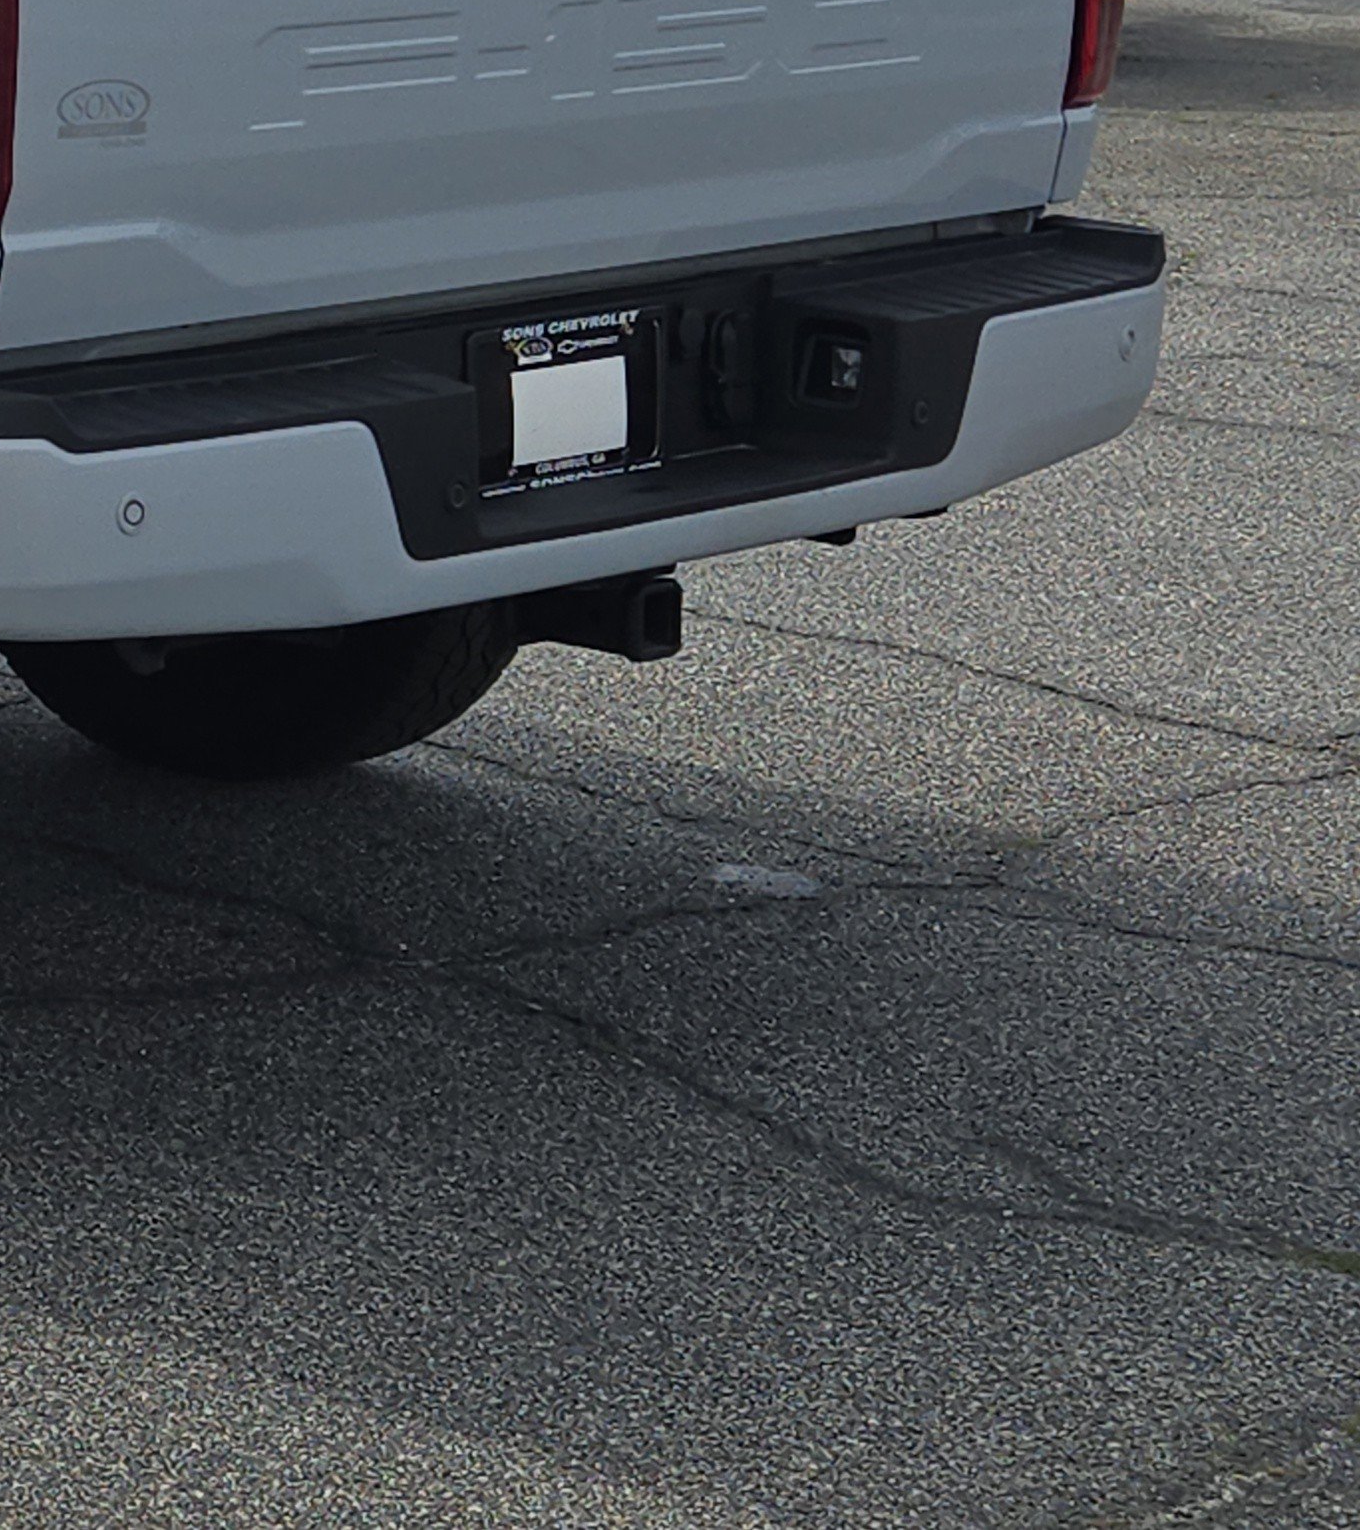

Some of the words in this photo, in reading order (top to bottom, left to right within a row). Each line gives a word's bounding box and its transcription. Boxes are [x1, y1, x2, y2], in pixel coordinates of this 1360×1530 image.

[69, 90, 138, 121] SONS
[502, 323, 545, 342] SONS
[547, 309, 640, 334] CHEVROLET
